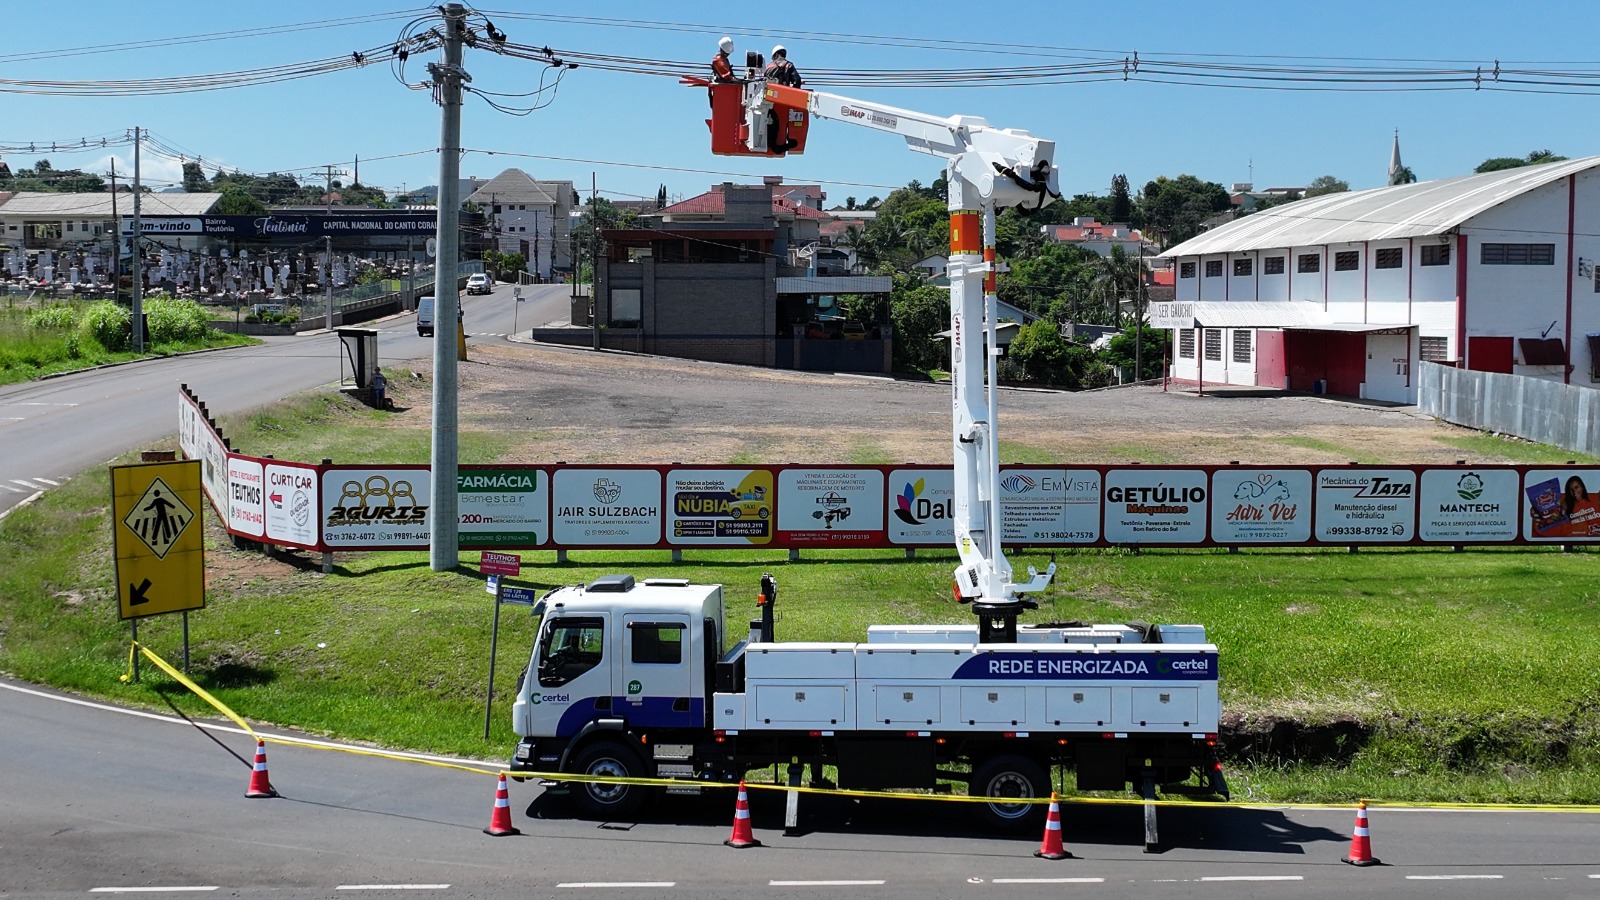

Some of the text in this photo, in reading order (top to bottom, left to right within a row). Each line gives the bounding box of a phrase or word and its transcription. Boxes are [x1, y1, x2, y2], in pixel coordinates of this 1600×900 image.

[850, 109, 865, 119] IMAP
[254, 216, 308, 235] Teutônia
[324, 222, 350, 230] CAPITAL
[351, 222, 382, 230] NACIONAL
[384, 222, 394, 230] DO
[394, 222, 416, 230] CANTO
[1159, 302, 1192, 318] SER GAÚCHO
[1322, 477, 1411, 495] Mecânica do TATA
[231, 482, 260, 505] TEUTHOS
[1107, 483, 1205, 502] GETÚLIO
[678, 495, 729, 512] NÚBIA
[1335, 504, 1375, 512] Manutenção
[1440, 504, 1499, 512] MANTECH
[327, 506, 429, 520] 3GURIS
[558, 507, 656, 516] JAIR SULZBACH
[1126, 504, 1188, 516] Máquinas
[1226, 503, 1297, 520] Adri Vet
[462, 514, 482, 523] 200
[1332, 527, 1388, 535] 99338-8792
[487, 553, 516, 562] TEUTHOS
[989, 660, 1148, 674] REDE ENERGIZADA
[1172, 658, 1208, 670] certel
[542, 693, 570, 702] certel
